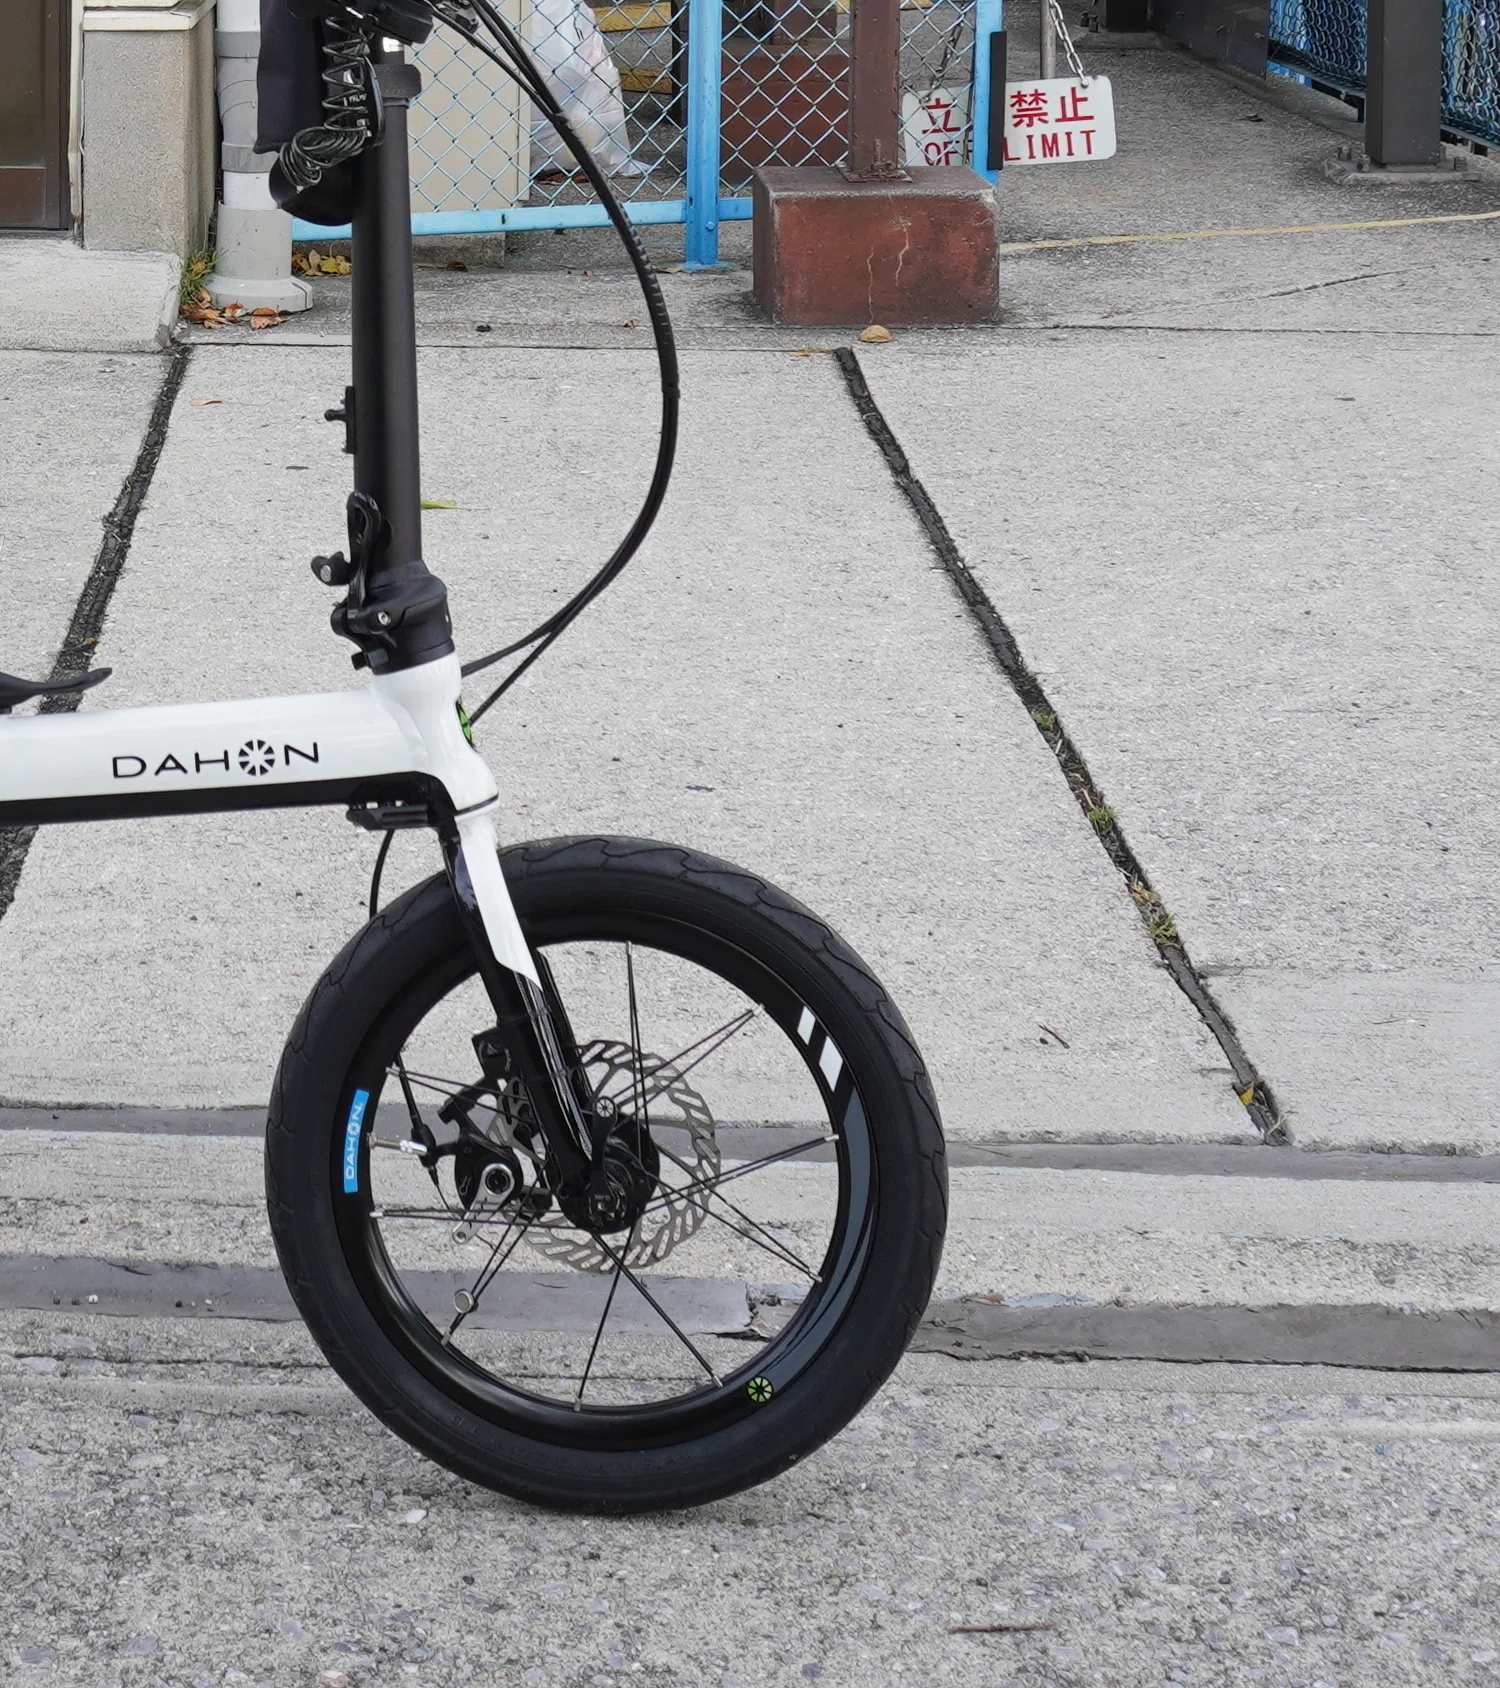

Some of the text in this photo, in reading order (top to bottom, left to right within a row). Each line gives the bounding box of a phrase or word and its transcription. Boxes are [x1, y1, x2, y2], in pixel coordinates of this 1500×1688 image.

[1003, 130, 1096, 162] LIMIT
[112, 739, 320, 779] DAHON
[345, 1102, 364, 1180] DAHON
